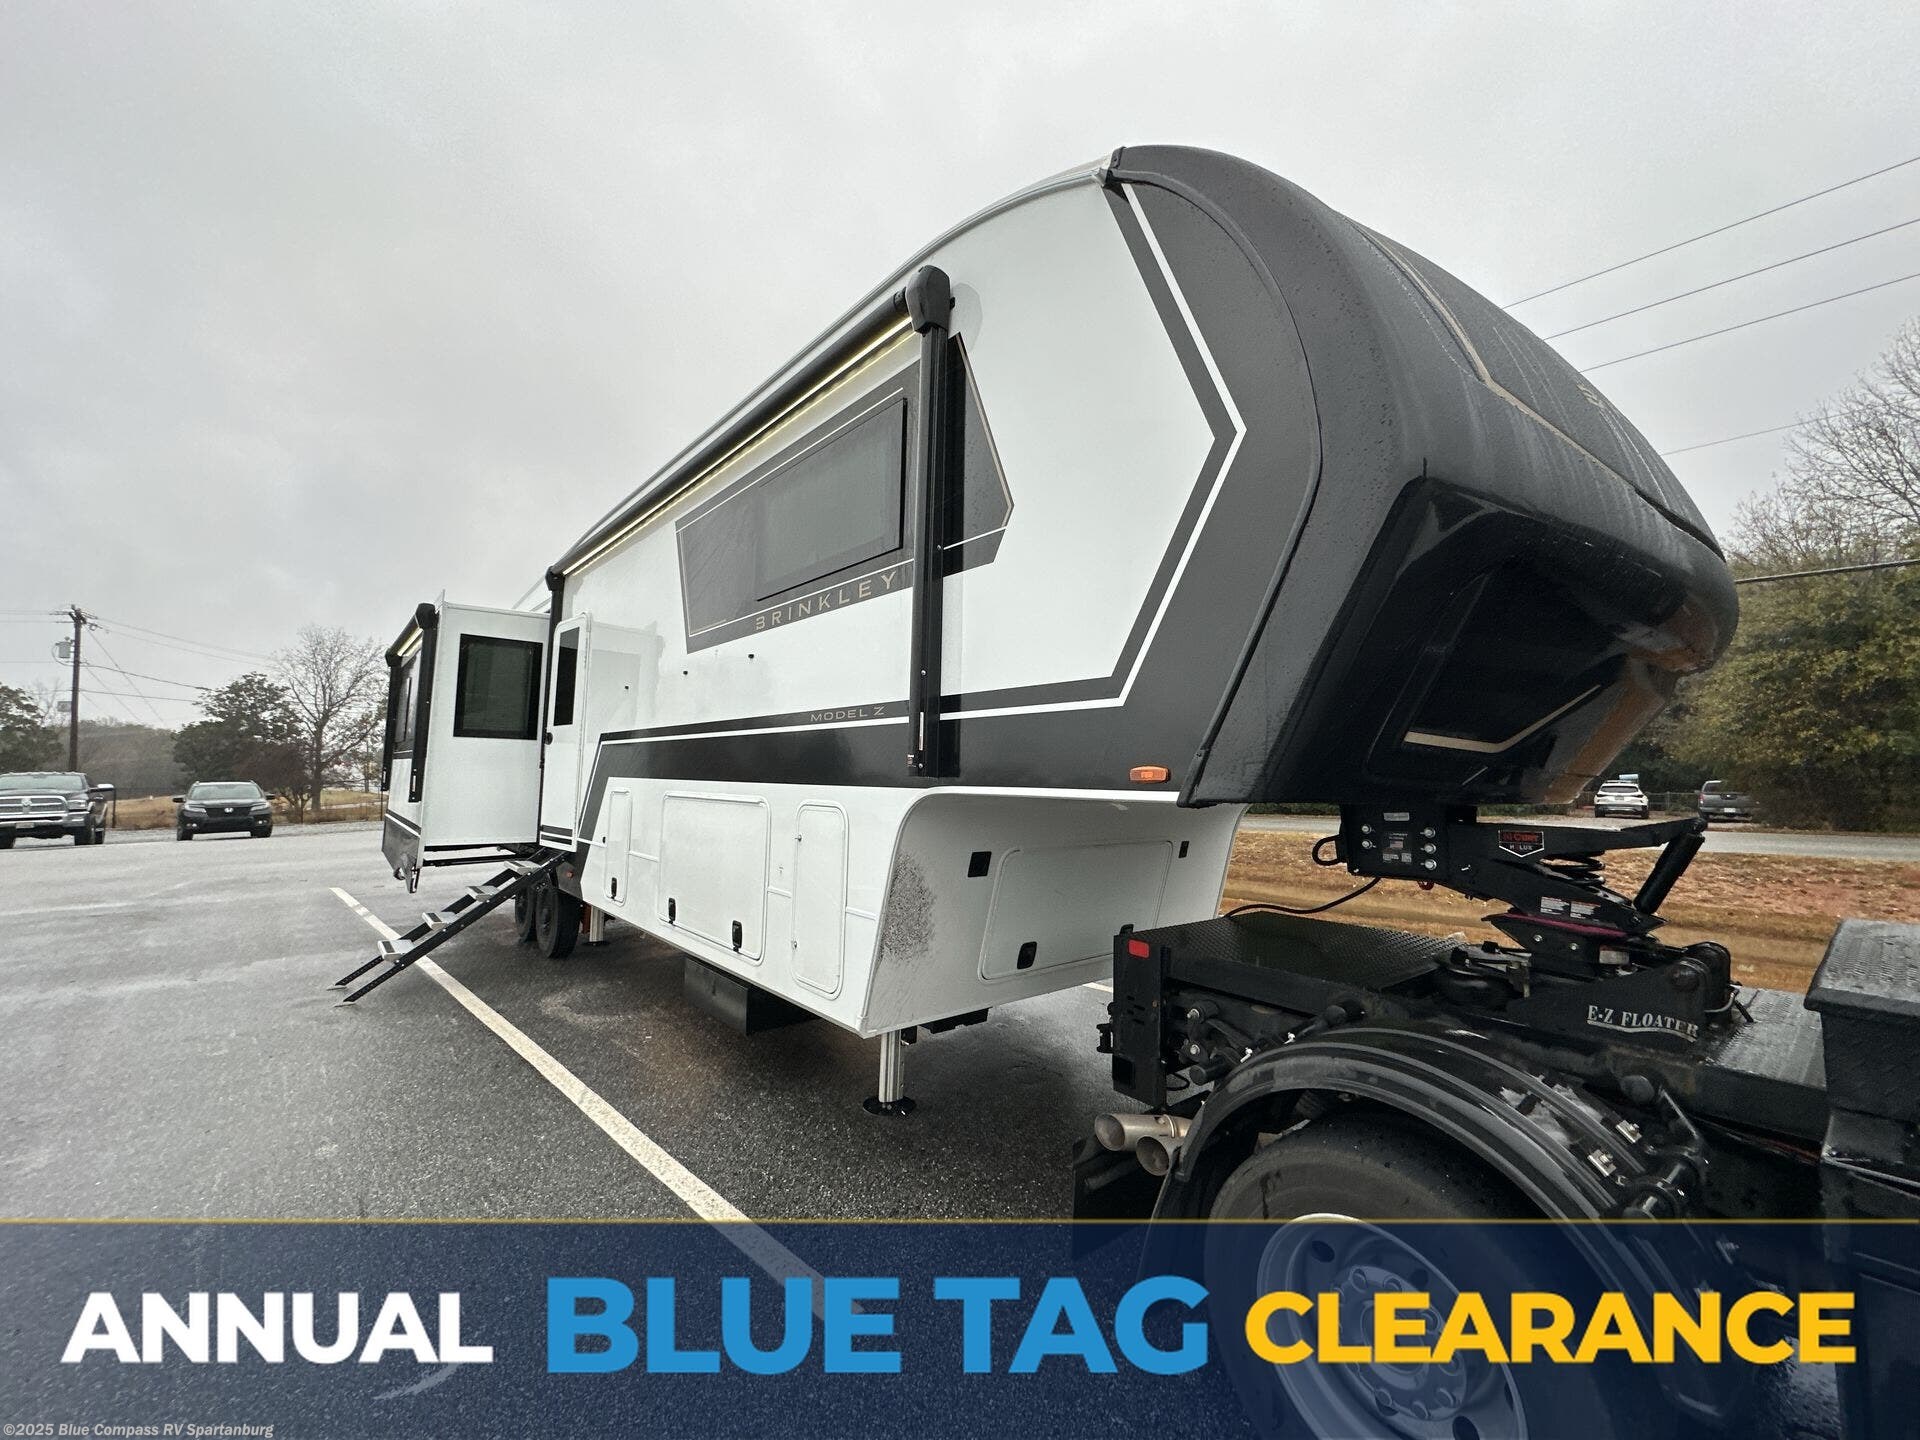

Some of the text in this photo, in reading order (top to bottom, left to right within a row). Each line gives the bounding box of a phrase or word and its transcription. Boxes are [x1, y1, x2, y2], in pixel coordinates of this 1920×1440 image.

[756, 571, 896, 630] BRINKLEY
[811, 705, 885, 721] MODEL Z
[1621, 1011, 1699, 1037] FLOATER
